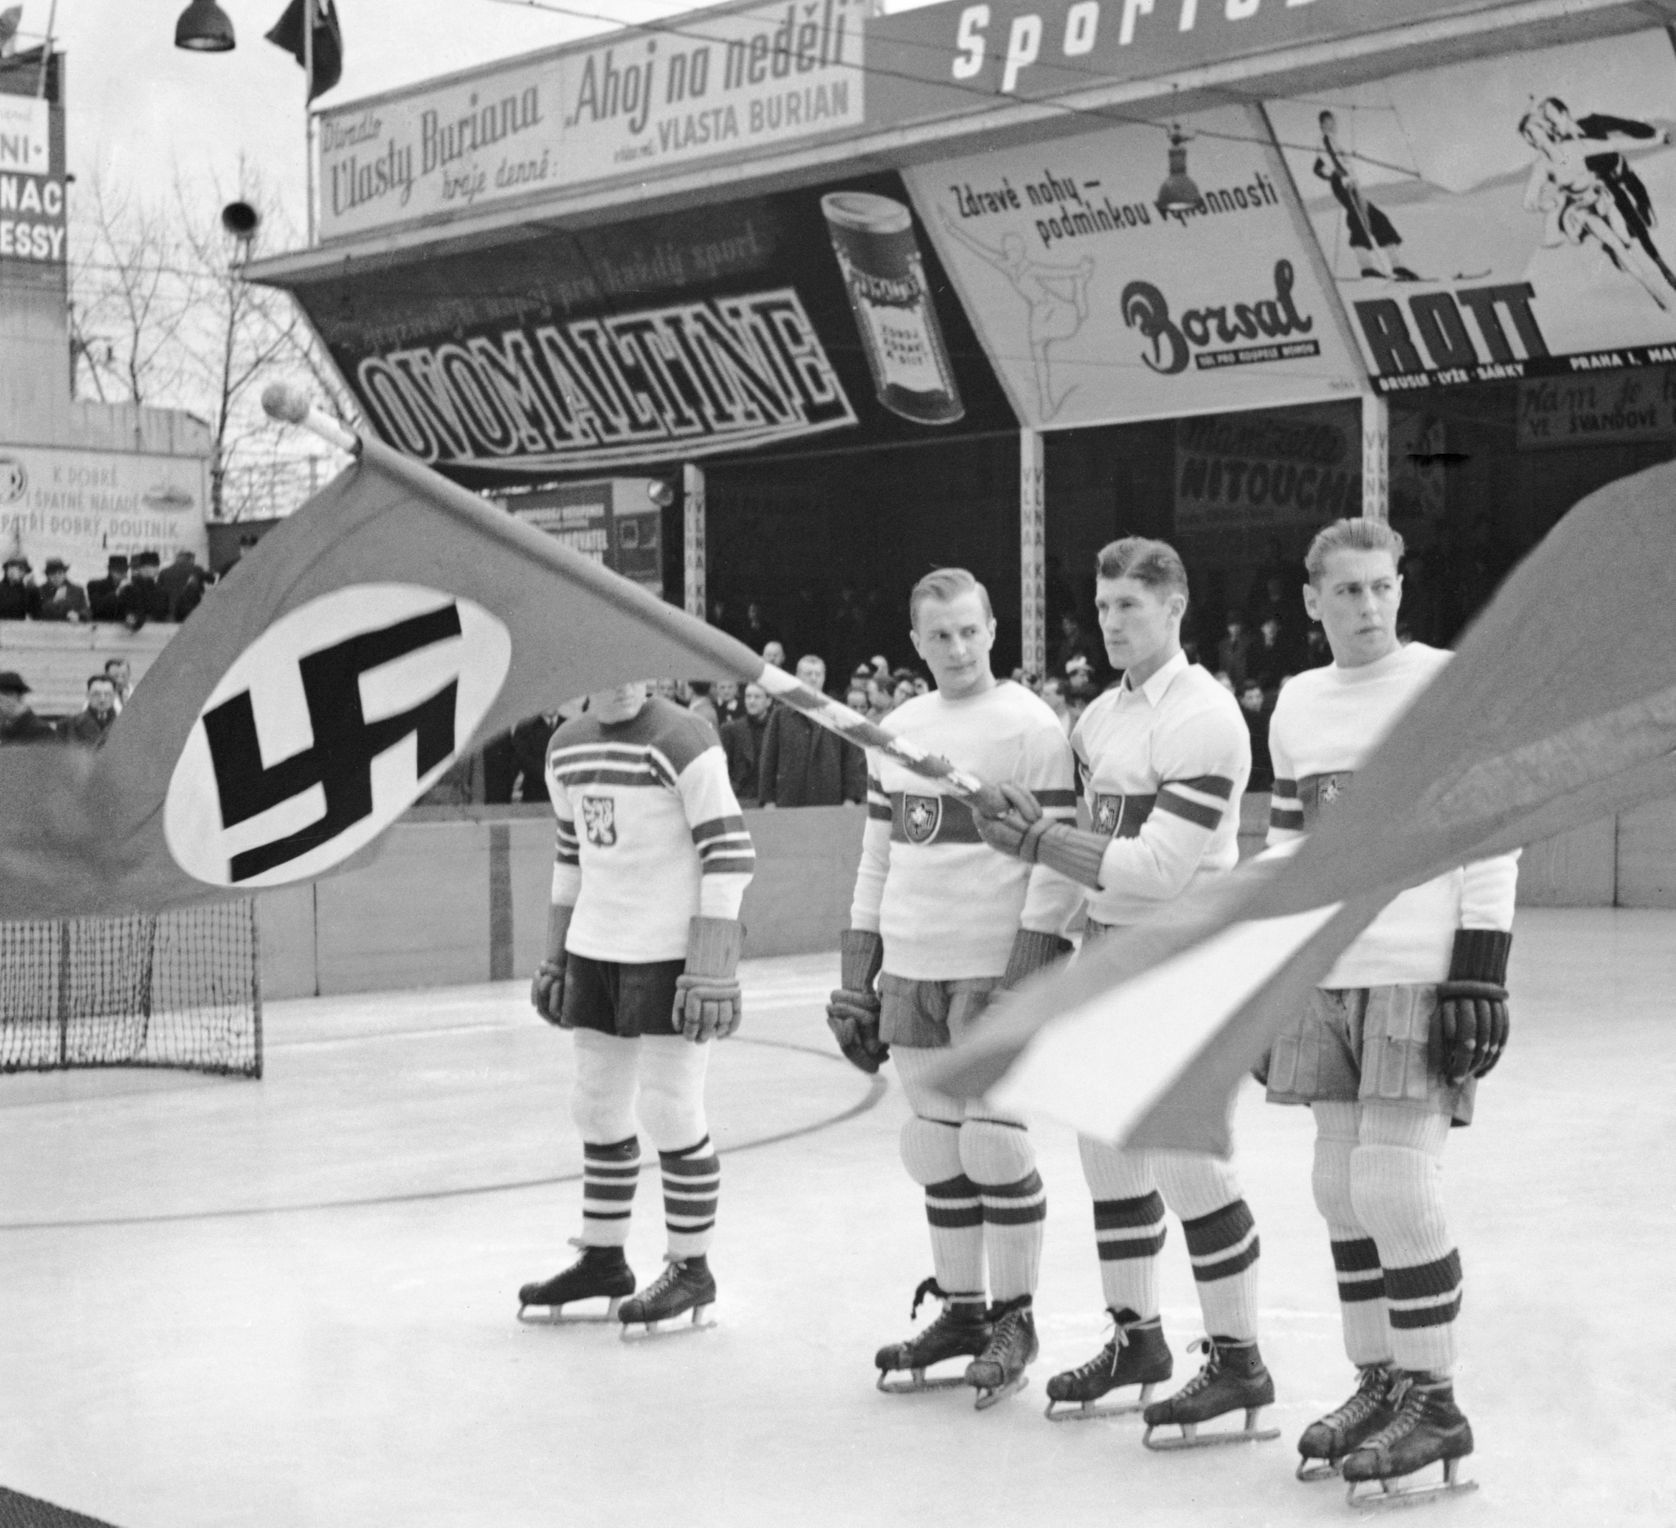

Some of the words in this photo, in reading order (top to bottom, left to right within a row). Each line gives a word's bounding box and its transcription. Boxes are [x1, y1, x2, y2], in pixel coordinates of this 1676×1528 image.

[666, 46, 711, 104] na
[723, 0, 848, 91] neděli
[332, 138, 415, 217] Vlasty
[421, 84, 545, 177] Buriana
[657, 104, 739, 152] VLASTA
[750, 80, 850, 134] BURIAN
[0, 176, 62, 216] NAC
[442, 163, 487, 204] hraje
[949, 177, 1022, 218] Zdravé
[1025, 168, 1084, 208] nohy
[1034, 197, 1152, 250] podmínkou
[1153, 171, 1280, 228] vonnosti
[0, 220, 65, 260] ESSY
[1121, 259, 1313, 375] Borsal
[1353, 281, 1551, 377] ROTT
[358, 287, 858, 465] OVOMALTINE
[1570, 353, 1624, 371] PRAHA
